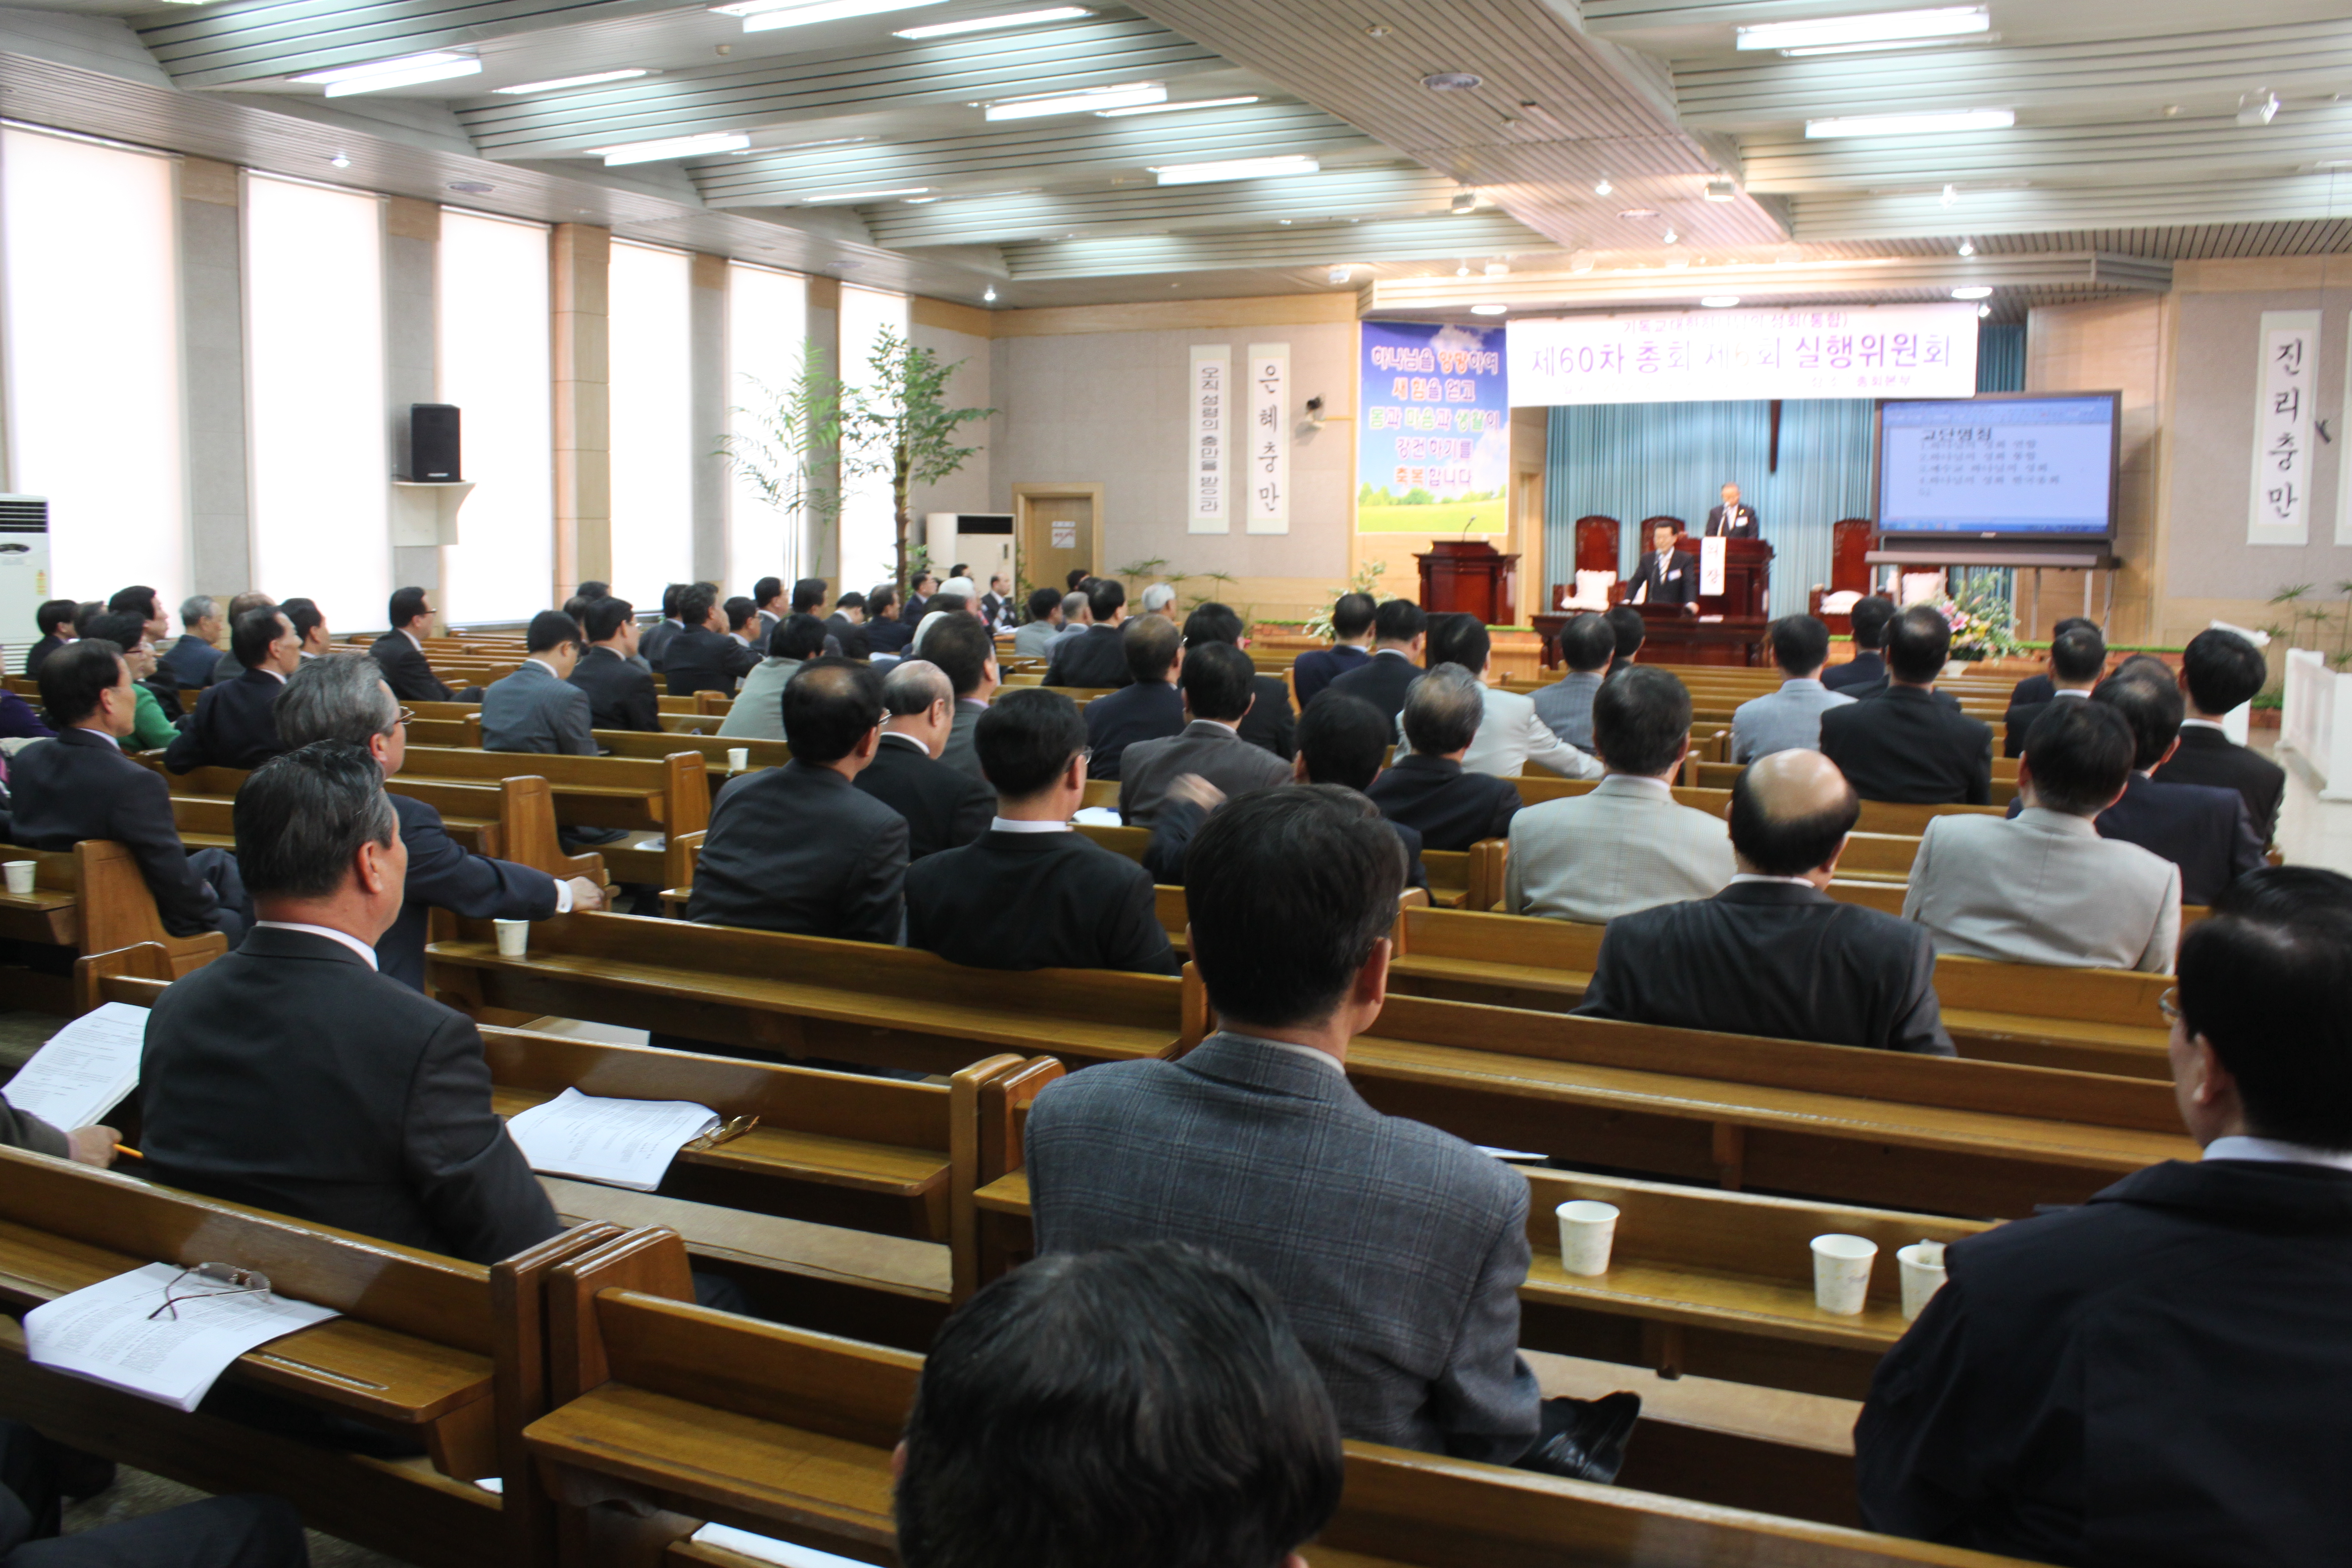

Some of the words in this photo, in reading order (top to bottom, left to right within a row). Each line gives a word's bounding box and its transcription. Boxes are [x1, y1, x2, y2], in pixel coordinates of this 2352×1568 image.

[1372, 346, 1434, 371] 하나님을
[1438, 350, 1498, 375] 앙망하여
[1531, 342, 1625, 377] 제60차
[1636, 340, 1689, 374] 총회
[1705, 337, 1780, 370] 제6회
[1795, 332, 1950, 369] 실행위원회
[1202, 366, 1219, 391] 오직
[1445, 379, 1476, 402] 얻고
[1201, 394, 1219, 431] 성령의
[1370, 407, 1402, 430] 몸과
[1405, 407, 1452, 431] 마음과
[1455, 409, 1500, 432] 생활이
